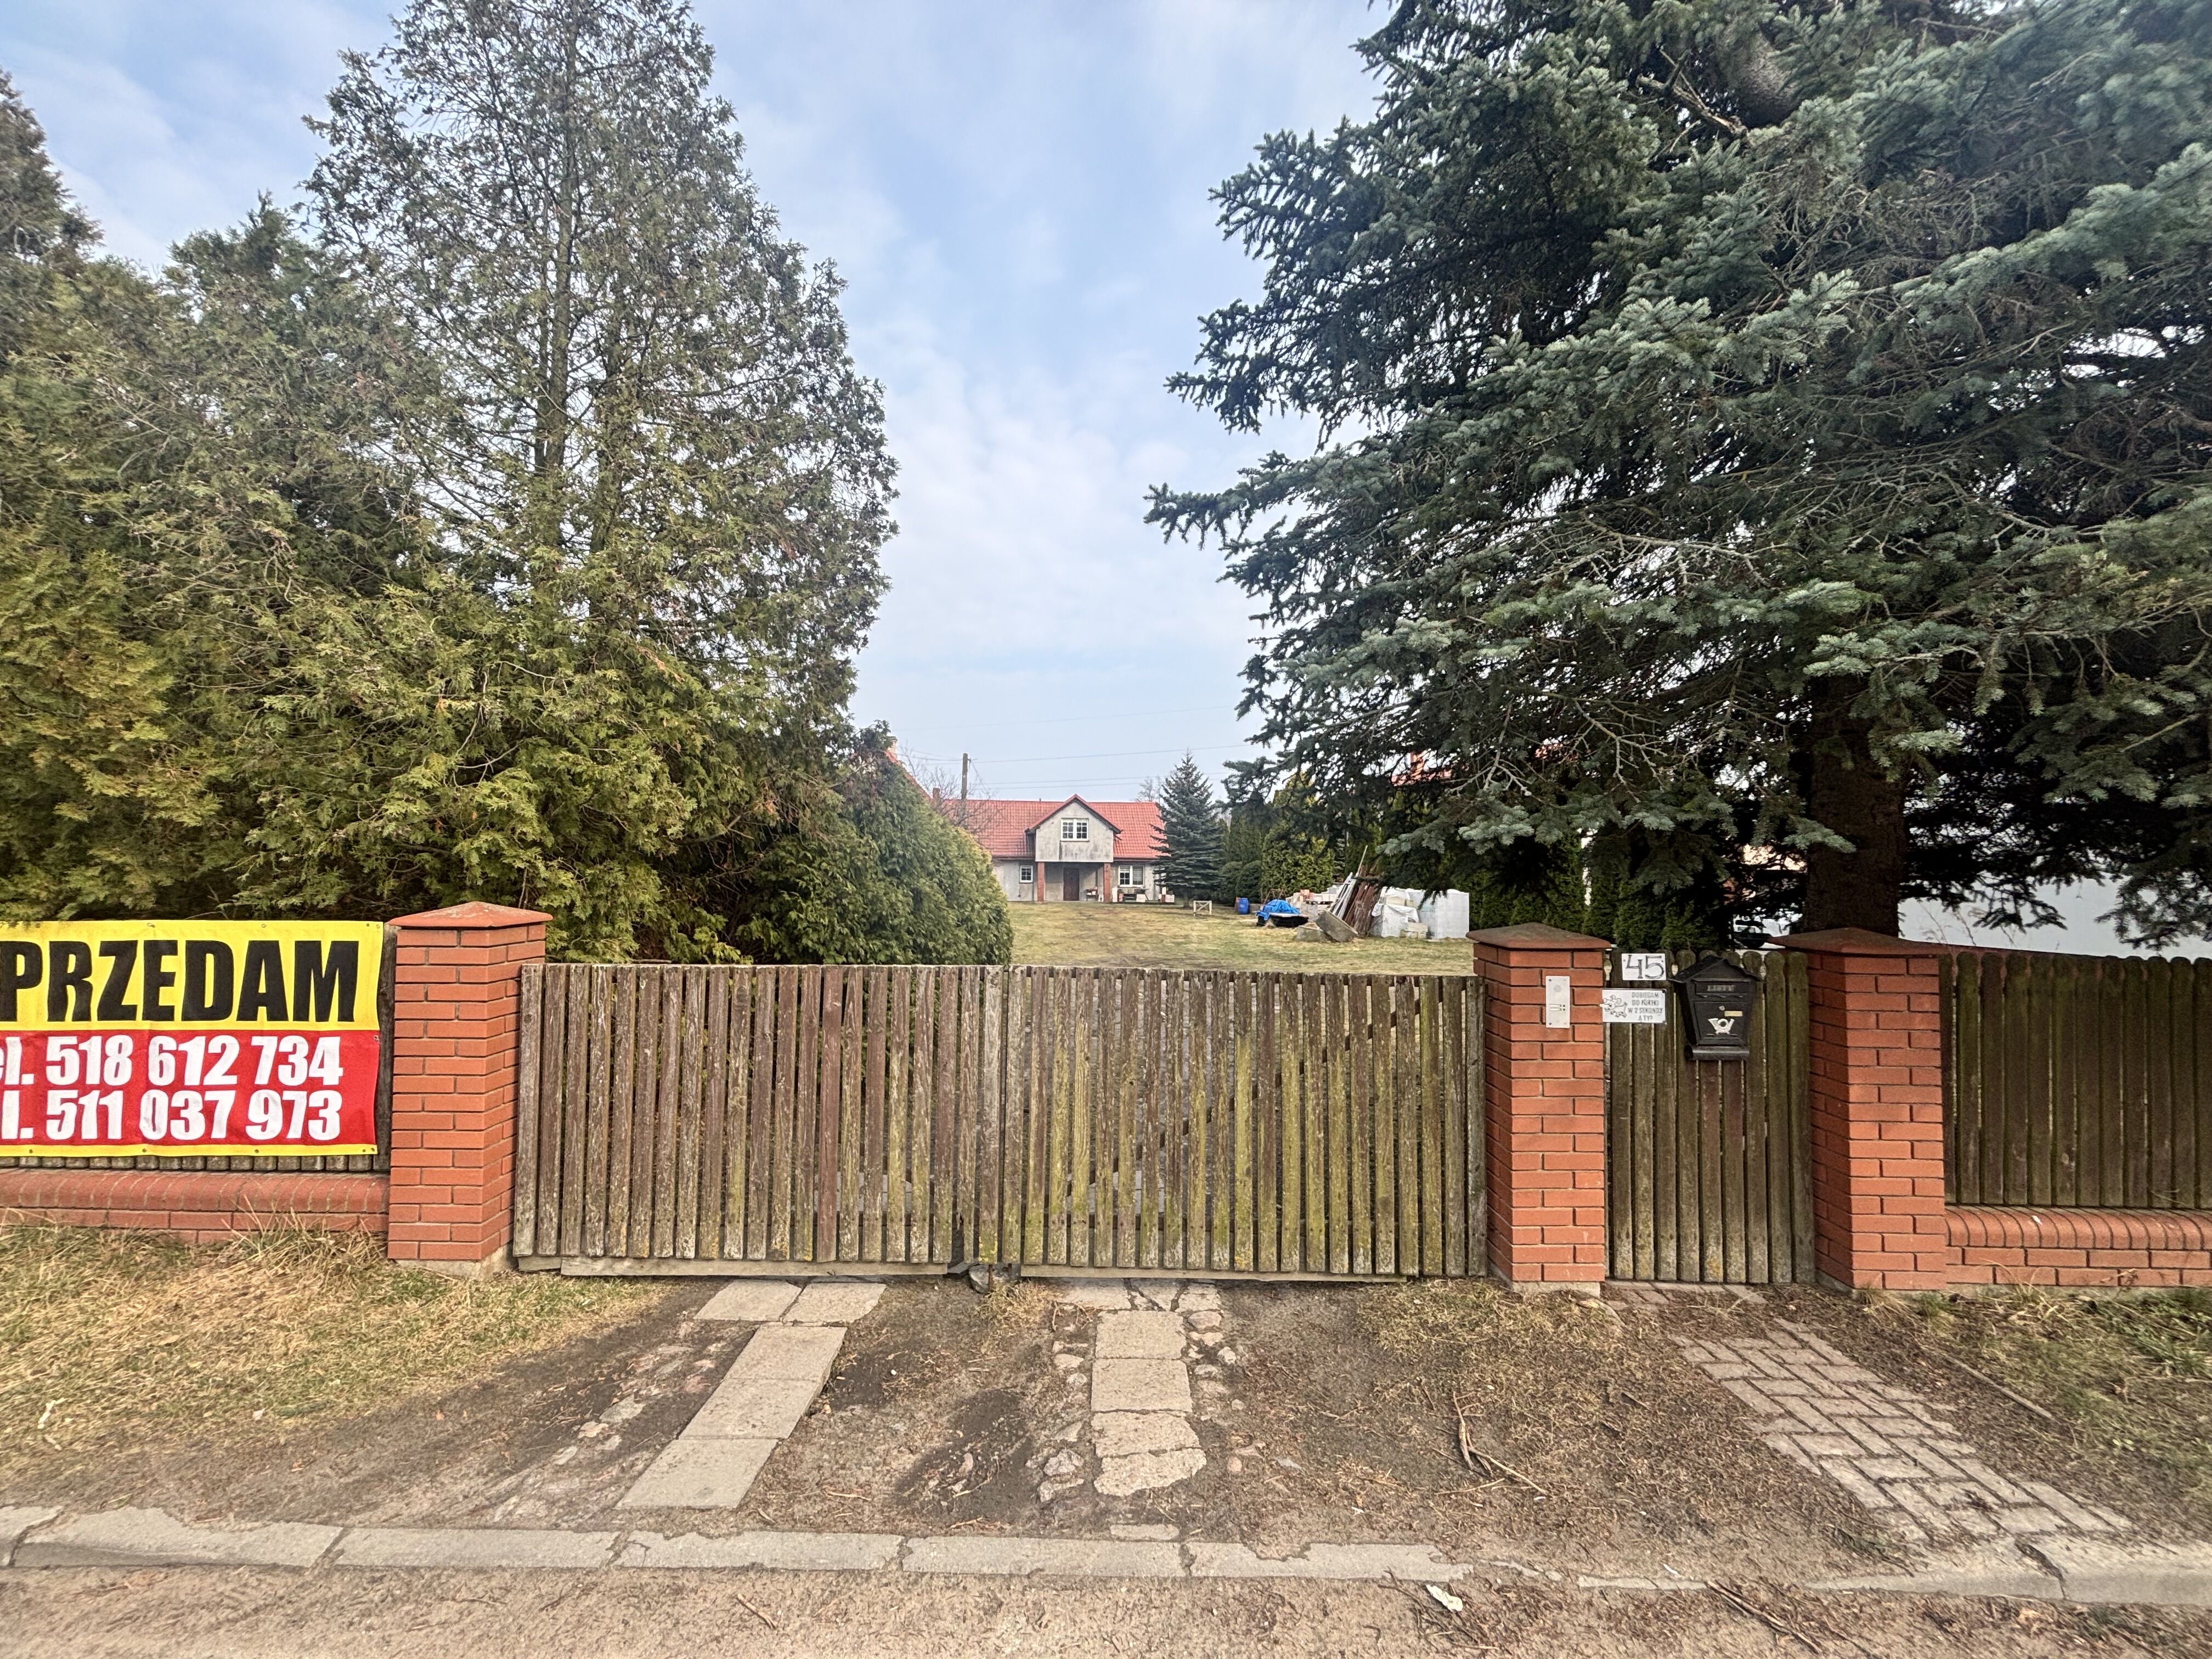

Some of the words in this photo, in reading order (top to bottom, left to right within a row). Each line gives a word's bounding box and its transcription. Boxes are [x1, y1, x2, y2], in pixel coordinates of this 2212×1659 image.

[0, 940, 359, 1022] PRZEDAM
[1626, 955, 1664, 979] 45
[0, 1036, 34, 1085] l.
[46, 1035, 133, 1086] 518
[148, 1035, 240, 1086] 612
[251, 1036, 343, 1086] 734
[46, 1090, 123, 1140] 511
[139, 1090, 236, 1140] 037
[245, 1090, 342, 1140] 973
